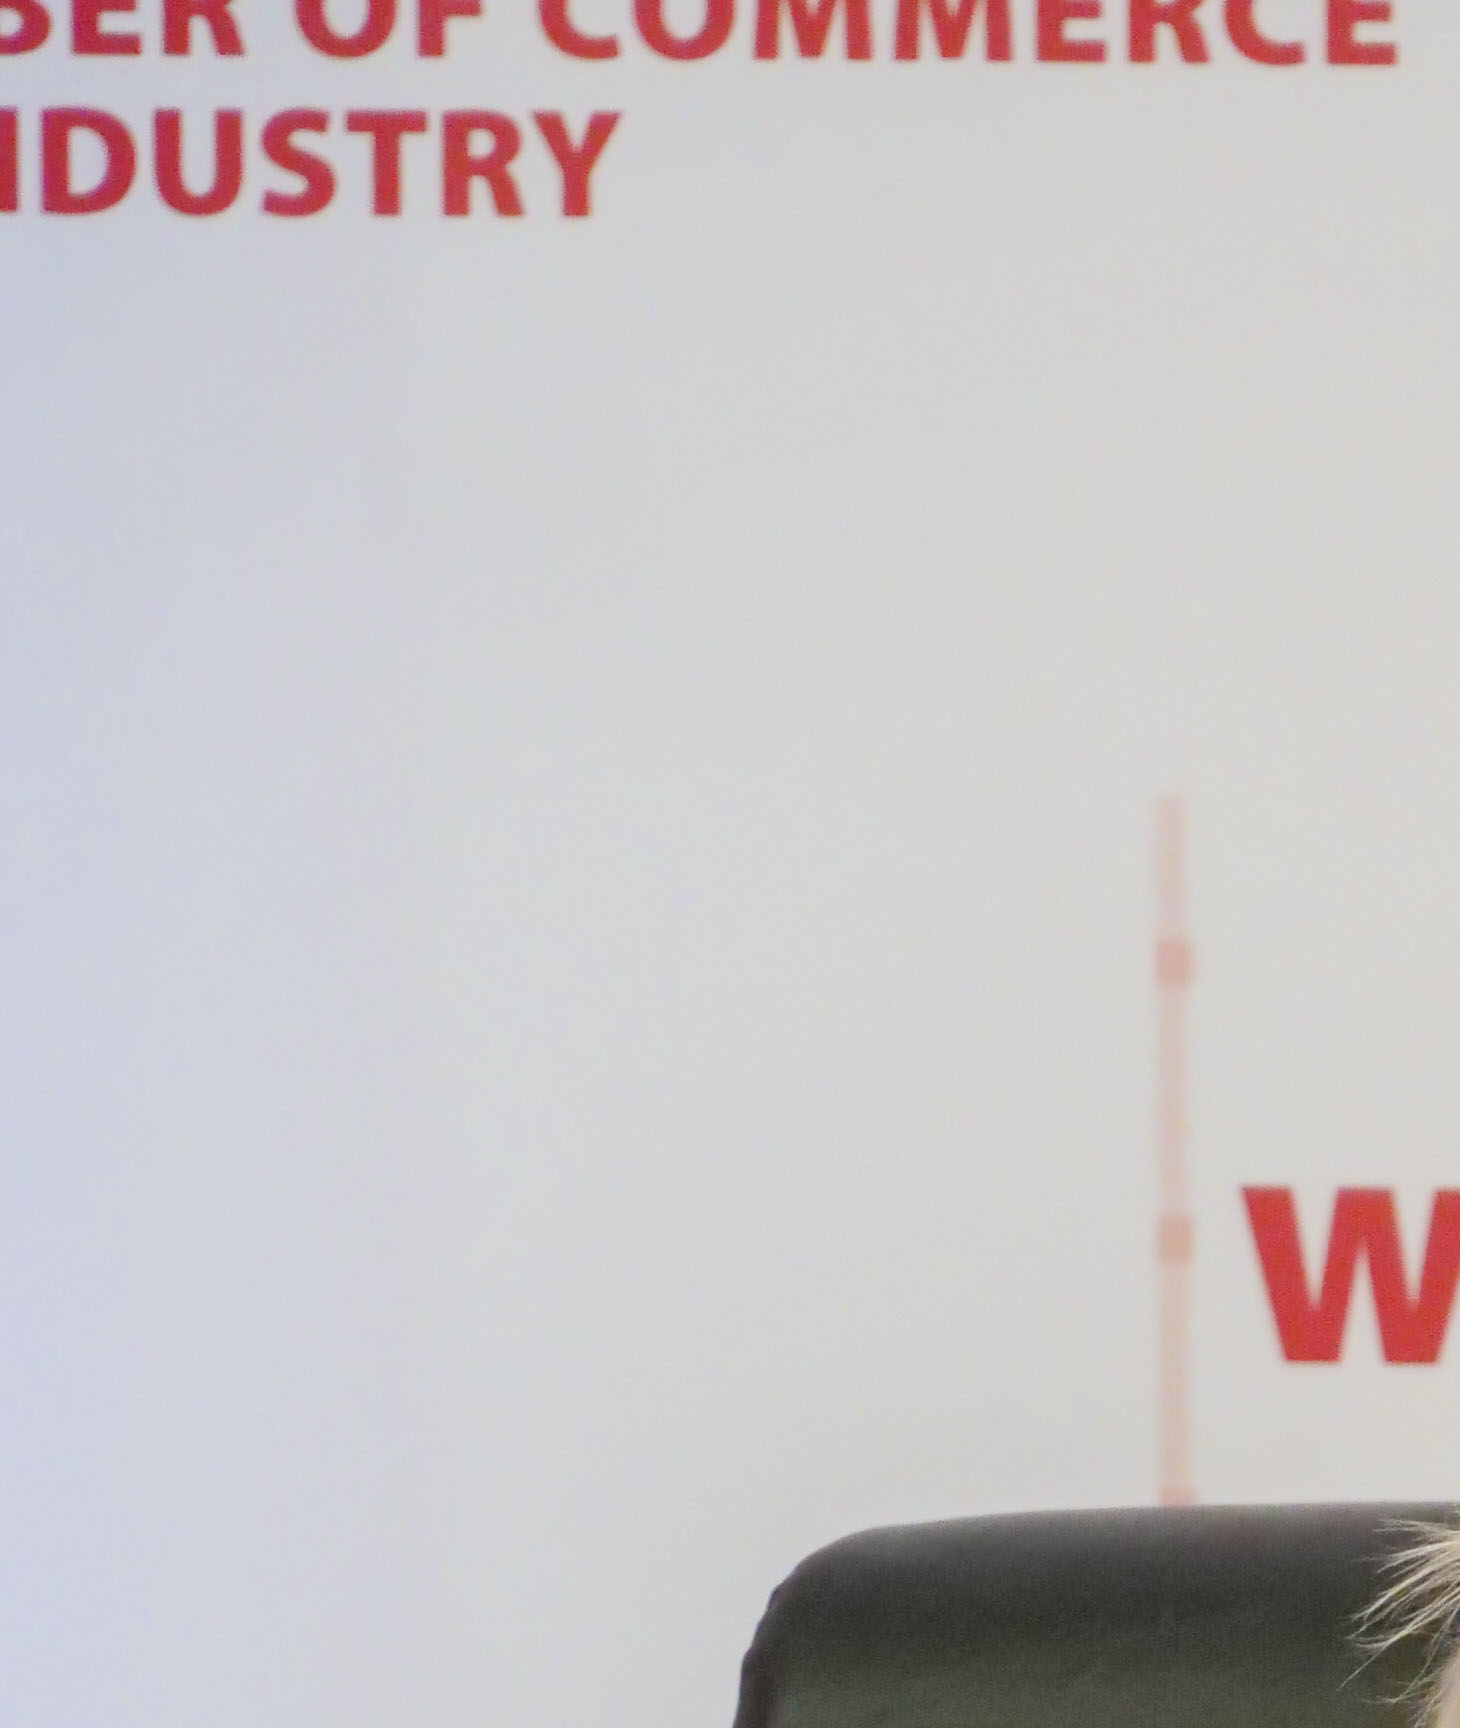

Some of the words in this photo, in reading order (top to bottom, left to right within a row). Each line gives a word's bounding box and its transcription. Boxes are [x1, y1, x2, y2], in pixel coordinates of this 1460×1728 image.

[295, 0, 482, 58] OF
[539, 0, 1397, 66] COMMERCE
[0, 107, 620, 217] DUSTRY
